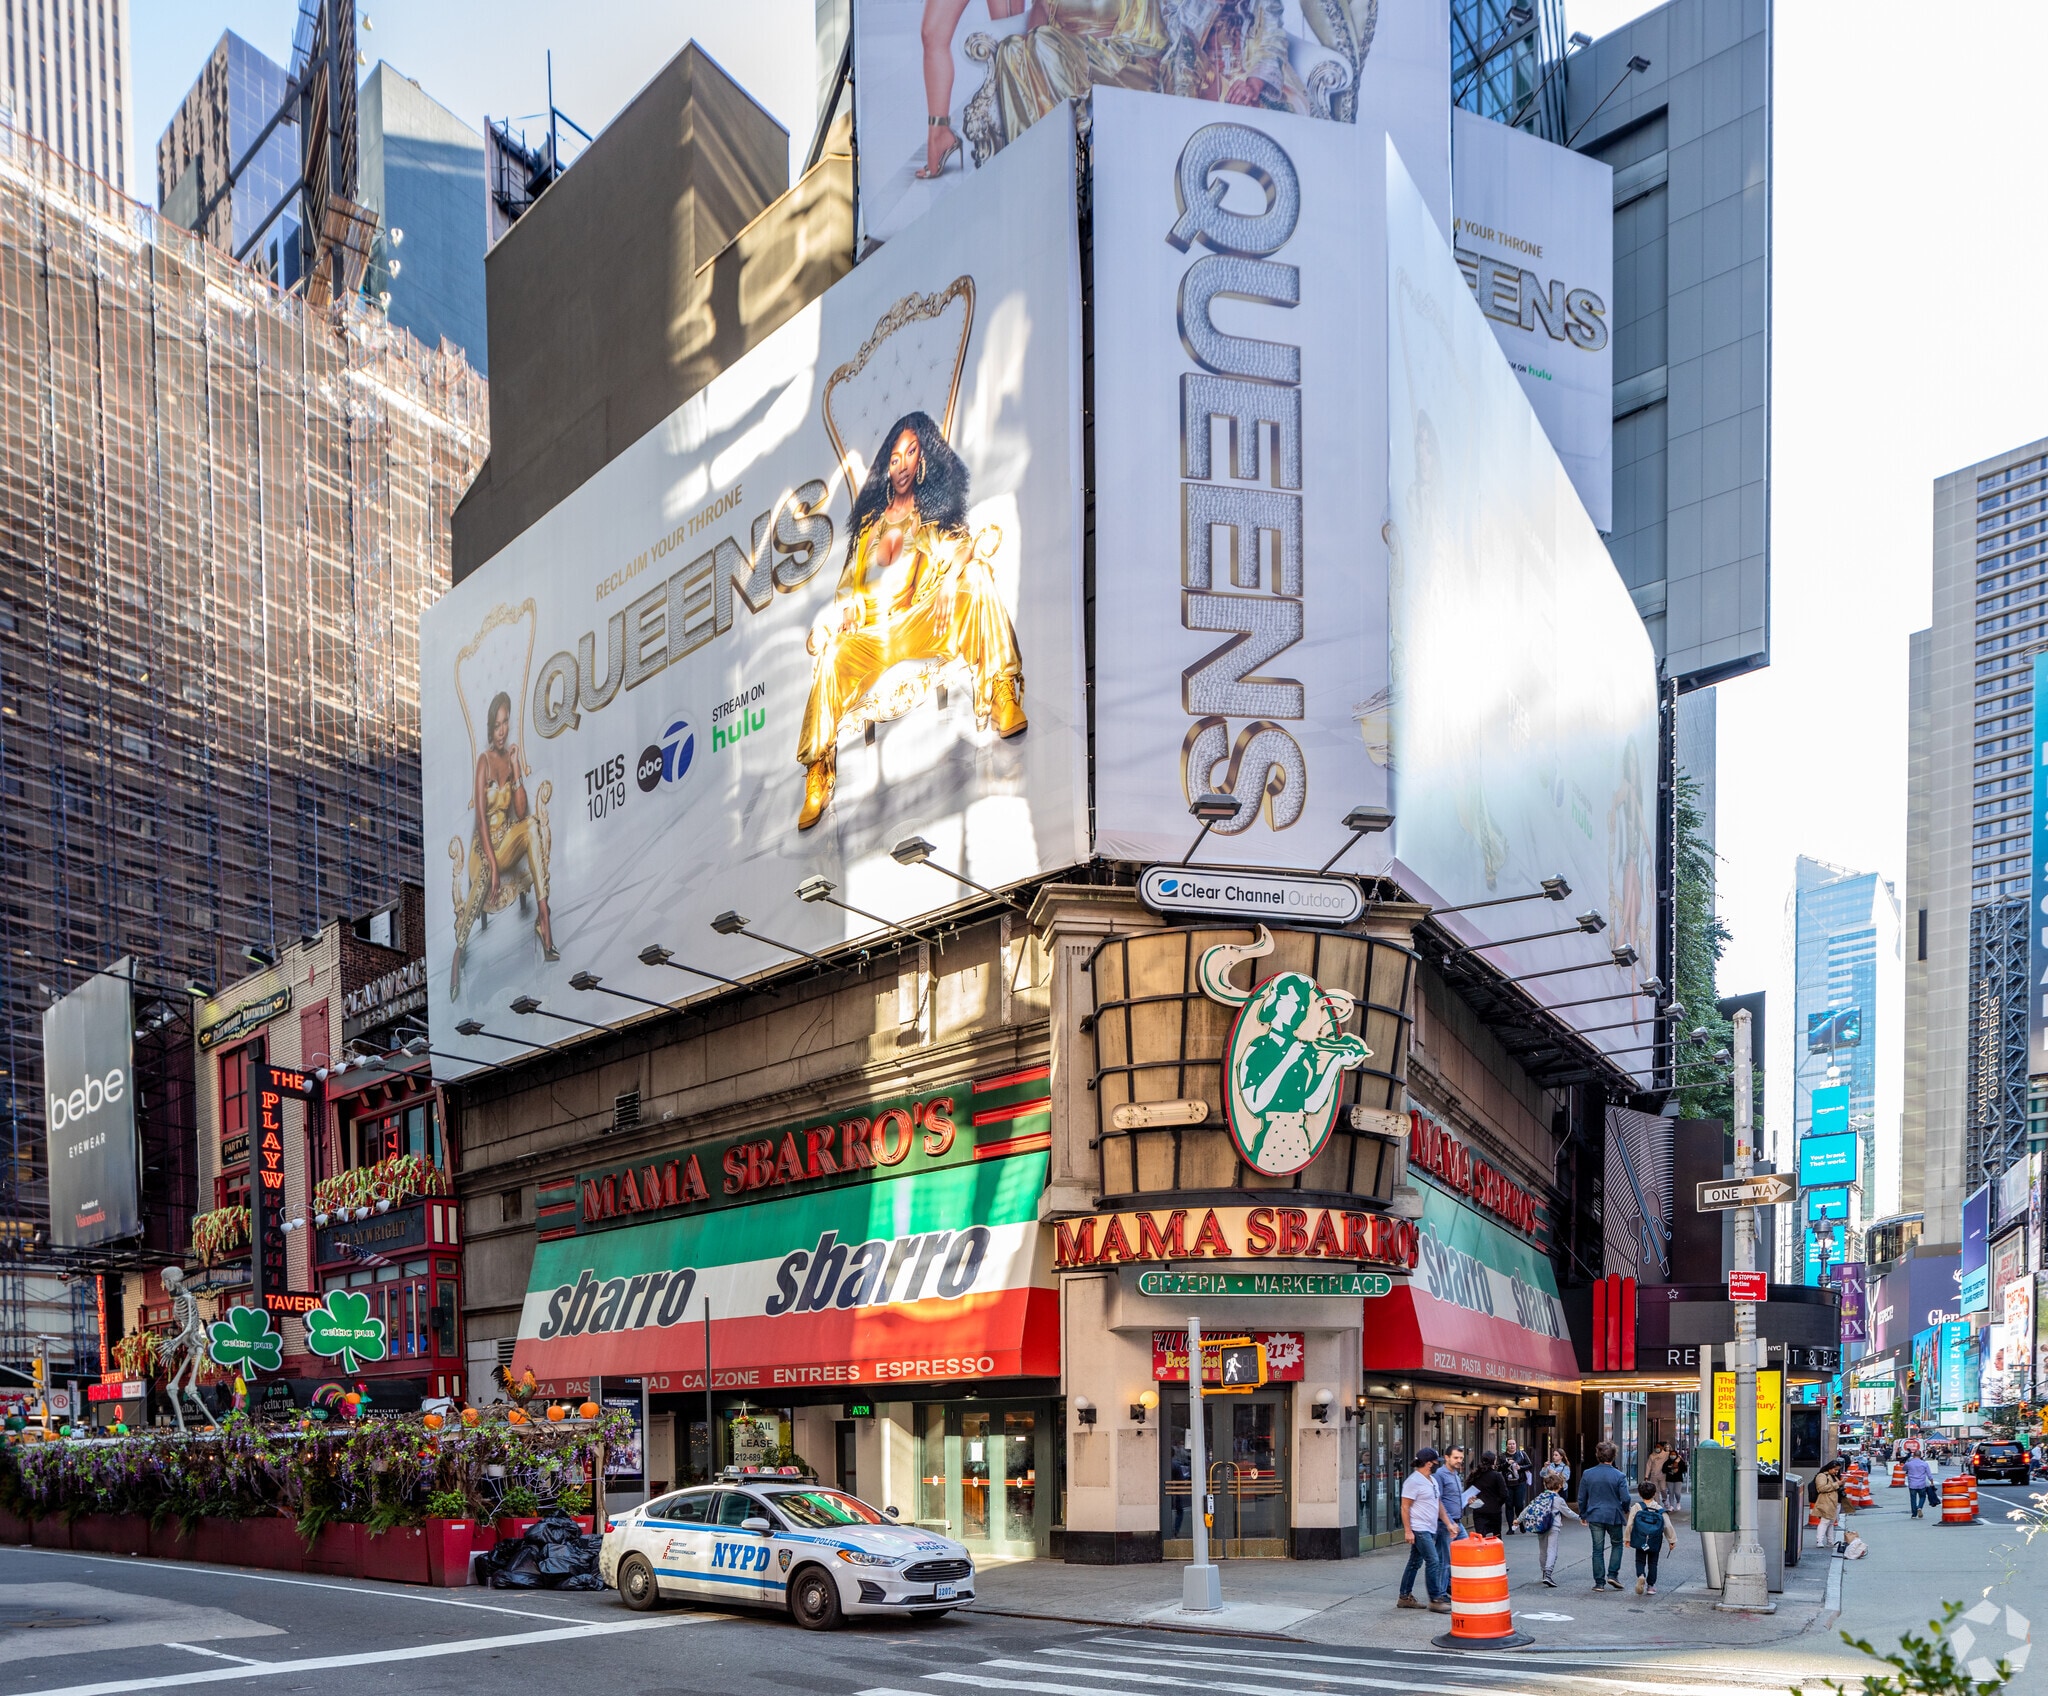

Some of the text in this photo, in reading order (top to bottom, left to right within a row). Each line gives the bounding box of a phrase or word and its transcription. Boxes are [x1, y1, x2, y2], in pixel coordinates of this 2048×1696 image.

[1464, 219, 1495, 242] YOUR
[1497, 231, 1544, 259] THRONE
[1528, 364, 1552, 381] hulu
[1166, 122, 1308, 836] QUEENS
[596, 484, 743, 602] RECLAIM YOUR THRONE
[533, 478, 834, 739] QUEENS
[712, 682, 765, 722] STREAM ON
[712, 707, 766, 753] hulu
[585, 754, 625, 795] TUES
[638, 757, 663, 780] abc
[587, 782, 625, 821] 10/19
[1181, 883, 1346, 909] Clear Channel Outdoor
[1978, 977, 1989, 1123] AMERICAN EAGLE
[1988, 996, 2000, 1099] OUTFITTERS
[270, 1070, 305, 1090] THE
[51, 1068, 124, 1132] bebe
[69, 1132, 106, 1159] EYEWEAR
[224, 1138, 243, 1156] PARTY
[582, 1096, 957, 1223] MAMA SBARRO'S
[1410, 1109, 1537, 1236] MAMA SBARRO'S
[1711, 1183, 1782, 1201] ONE WAY
[341, 1220, 406, 1244] PLAYWRIGHT
[1054, 1208, 1232, 1267] MAMA
[765, 1228, 991, 1317] sbarro
[1147, 1275, 1385, 1294] PIZZERIA MARKETPLACE
[1421, 1222, 1495, 1319] sbarro
[1731, 1280, 1751, 1288] Anytime
[265, 1294, 323, 1312] TAVERN
[538, 1268, 697, 1341] sbarro
[1511, 1267, 1561, 1340] sbarro
[1950, 1325, 1961, 1358] EAGLE
[682, 1370, 760, 1388] CALZONE
[773, 1364, 861, 1383] ENTREES
[875, 1356, 995, 1377] ESPRESSO
[1433, 1352, 1457, 1370] PIZZA
[1461, 1357, 1482, 1374] PASTA
[1485, 1362, 1506, 1379] SALAD
[1509, 1367, 1532, 1382] CALZONE
[1808, 1350, 1816, 1366] &
[101, 1372, 123, 1385] TAVERN
[852, 1405, 870, 1416] ATM
[741, 1439, 774, 1447] LEASE
[711, 1542, 770, 1572] NYPD
[815, 1537, 841, 1548] POLICE
